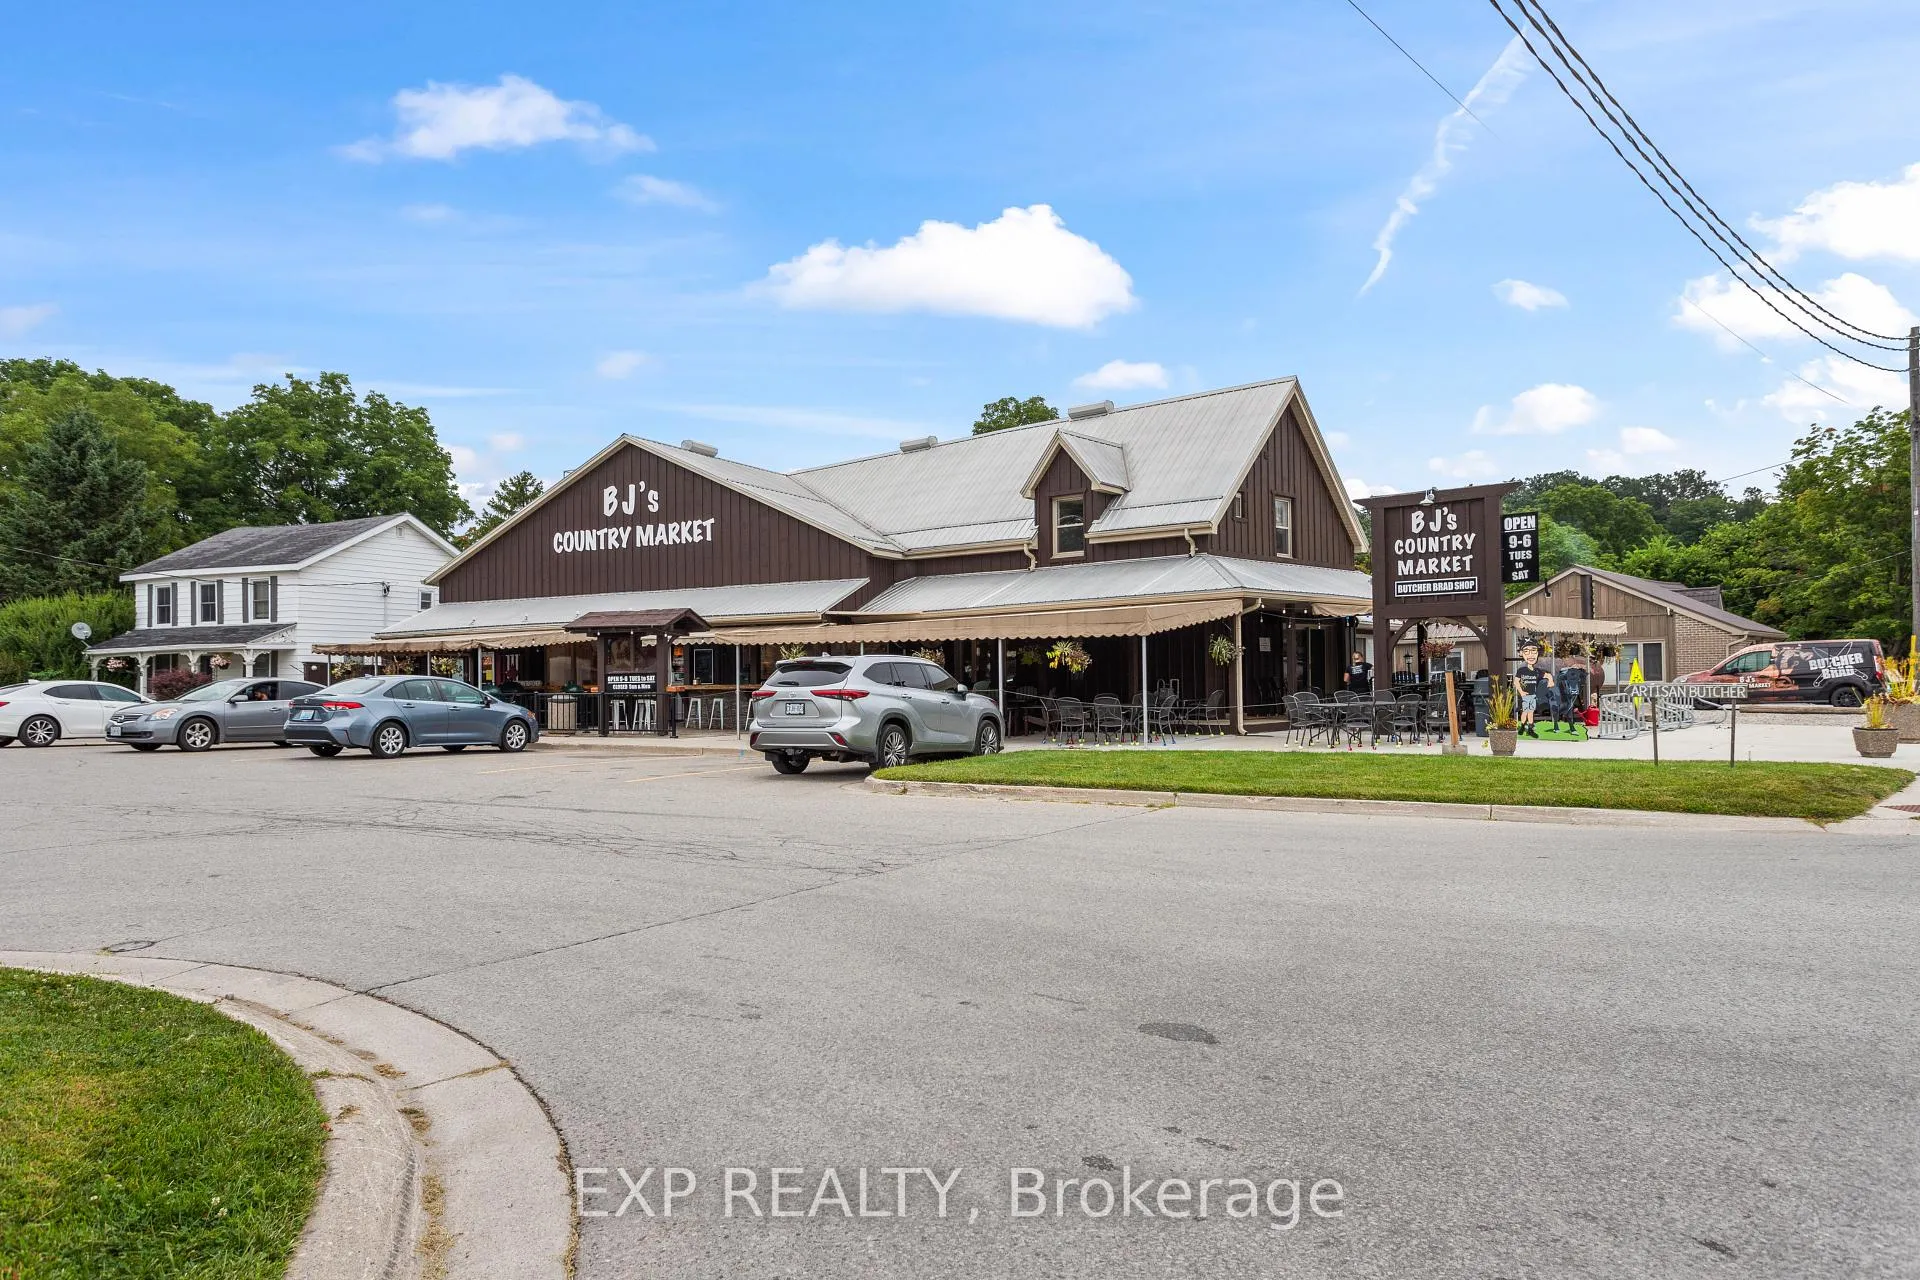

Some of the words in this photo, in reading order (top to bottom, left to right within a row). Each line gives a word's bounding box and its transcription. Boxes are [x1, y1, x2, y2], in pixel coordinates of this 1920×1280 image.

[603, 481, 659, 517] BJ's
[1411, 506, 1458, 534] BJ's
[1503, 515, 1536, 531] OPEN
[553, 526, 632, 554] COUNTRY
[635, 517, 715, 548] MARKET
[1394, 532, 1476, 555] COUNTRY
[1508, 534, 1532, 549] 9-6
[1508, 550, 1533, 560] TUES
[1397, 554, 1474, 576] MARKET
[1511, 570, 1529, 581] SAT
[1397, 583, 1432, 594] BUTCHER
[1432, 581, 1454, 592] BRAD
[1454, 580, 1475, 590] SHOP
[1808, 652, 1864, 671] BUTCHER
[1821, 665, 1855, 680] BRAD
[1631, 685, 1687, 698] ARTISAN
[1689, 685, 1746, 698] BUTCHER
